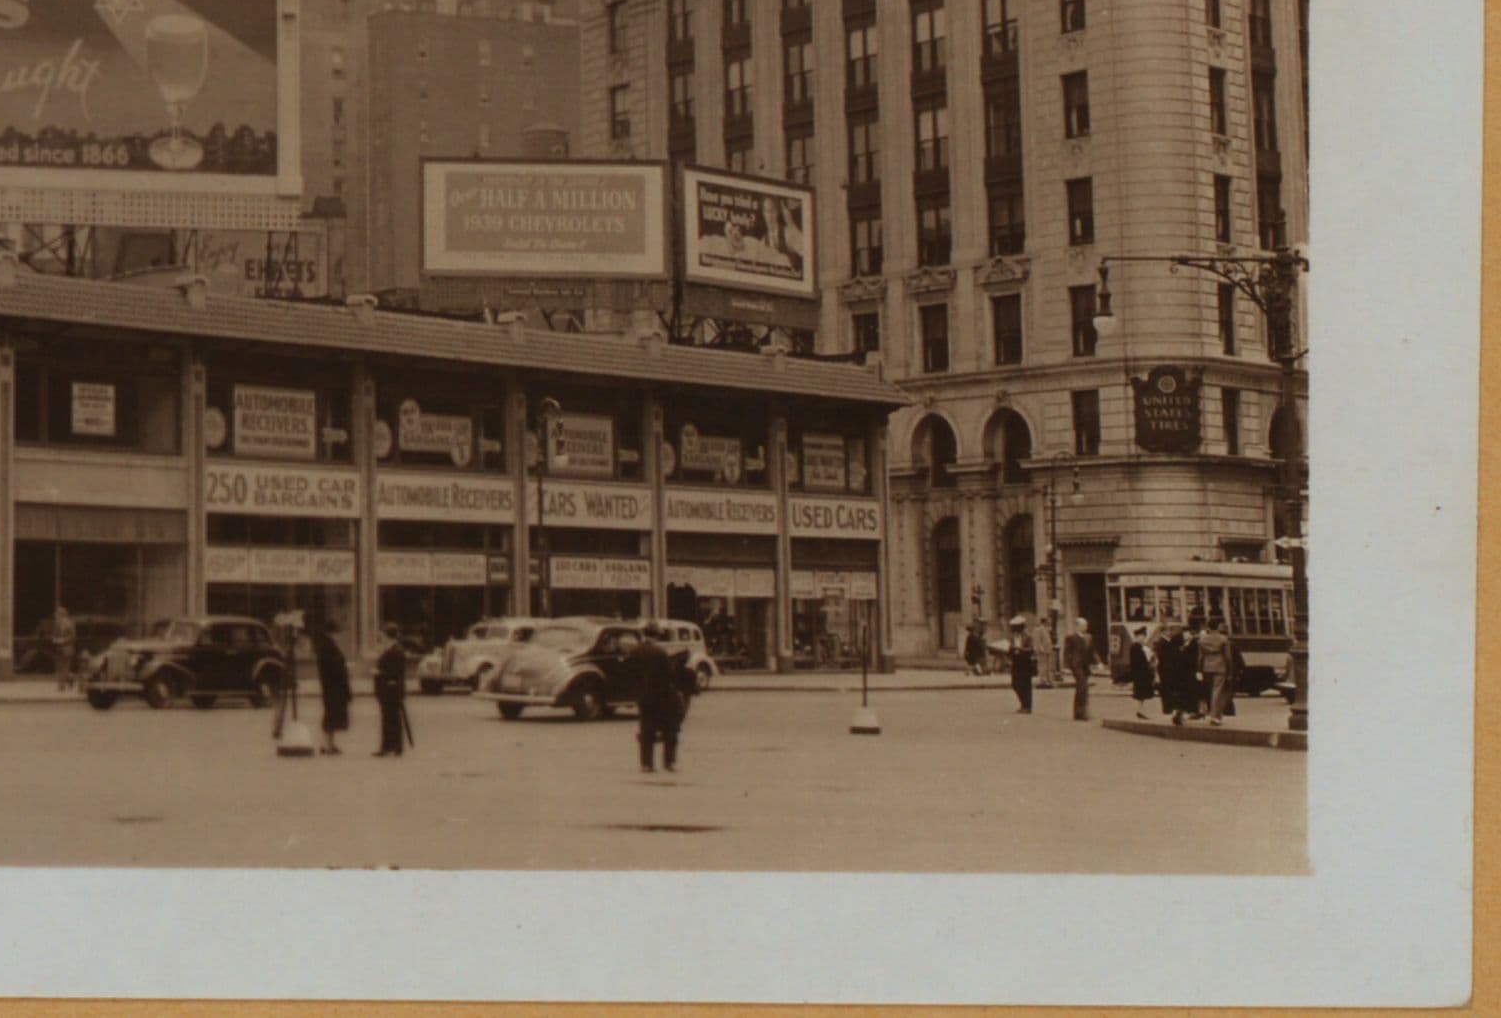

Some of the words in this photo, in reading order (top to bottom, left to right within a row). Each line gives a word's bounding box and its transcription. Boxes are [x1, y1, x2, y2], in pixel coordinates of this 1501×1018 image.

[24, 142, 74, 164] since
[82, 144, 130, 166] 1866
[480, 189, 528, 208] HALF
[534, 189, 546, 209] A
[553, 189, 636, 210] MILLION
[508, 214, 625, 233] CHEVROLETS
[236, 394, 314, 415] AUTOMOBILE
[206, 471, 248, 504] 250
[254, 473, 309, 490] USED
[318, 477, 356, 495] CAR
[254, 491, 354, 510] BARGAINS
[379, 482, 450, 508] AUTOMOBILE
[452, 483, 512, 510] RECEIVERS
[543, 493, 577, 517] CARS
[583, 492, 638, 519] WANTED
[792, 504, 833, 529] USED
[836, 505, 878, 531] CARS
